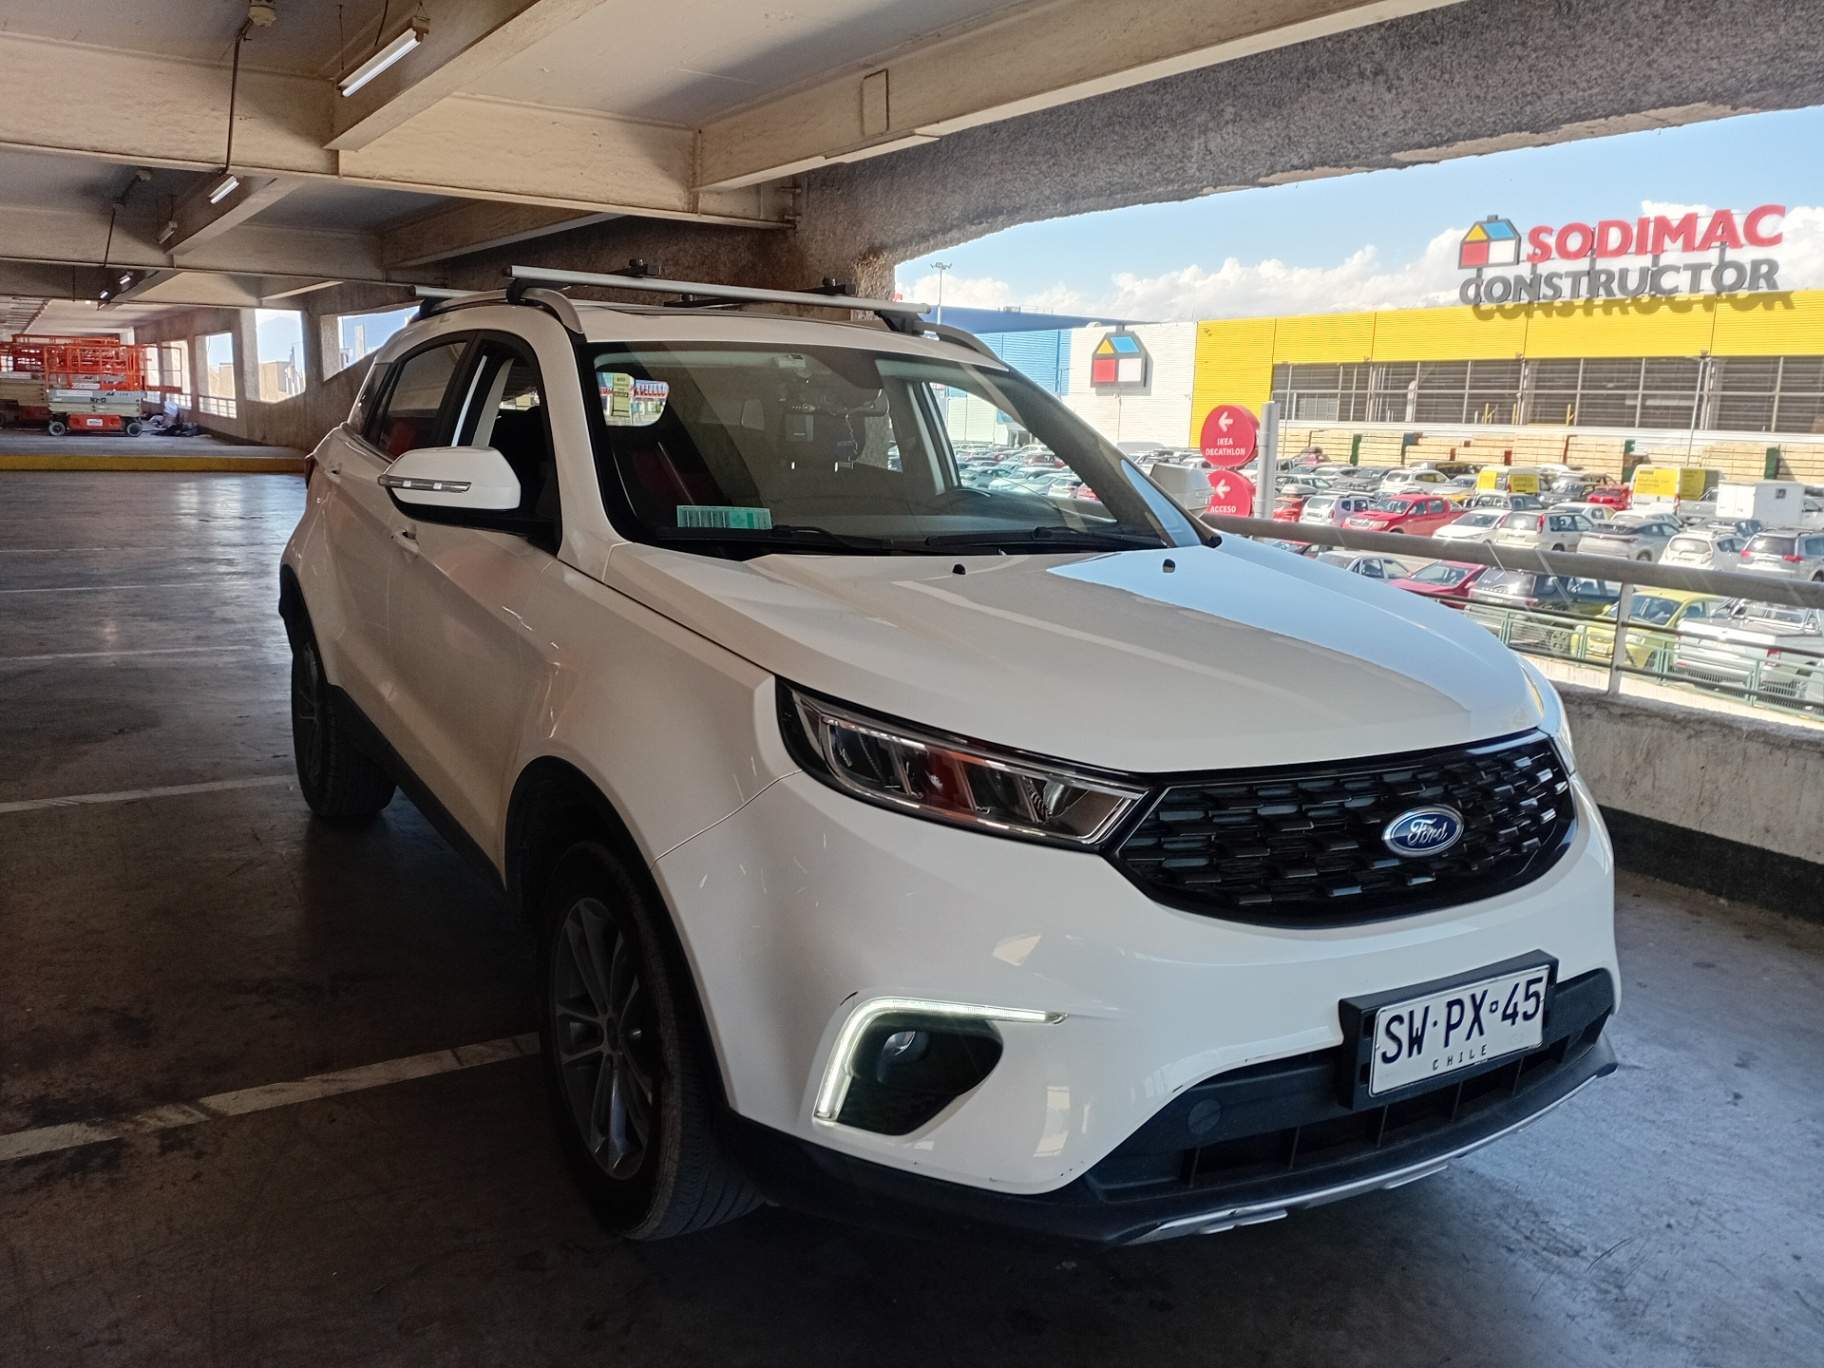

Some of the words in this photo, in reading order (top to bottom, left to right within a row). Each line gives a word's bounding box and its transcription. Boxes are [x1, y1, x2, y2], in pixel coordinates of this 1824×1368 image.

[1526, 204, 1786, 264] SODIMAC
[1458, 258, 1780, 306] CONSTRUCTOR
[1205, 447, 1246, 456] DECATHLON
[1217, 437, 1233, 446] IKEA
[1210, 505, 1237, 514] ACCESO
[1407, 817, 1450, 847] Ford
[1432, 1044, 1488, 1071] CHILE
